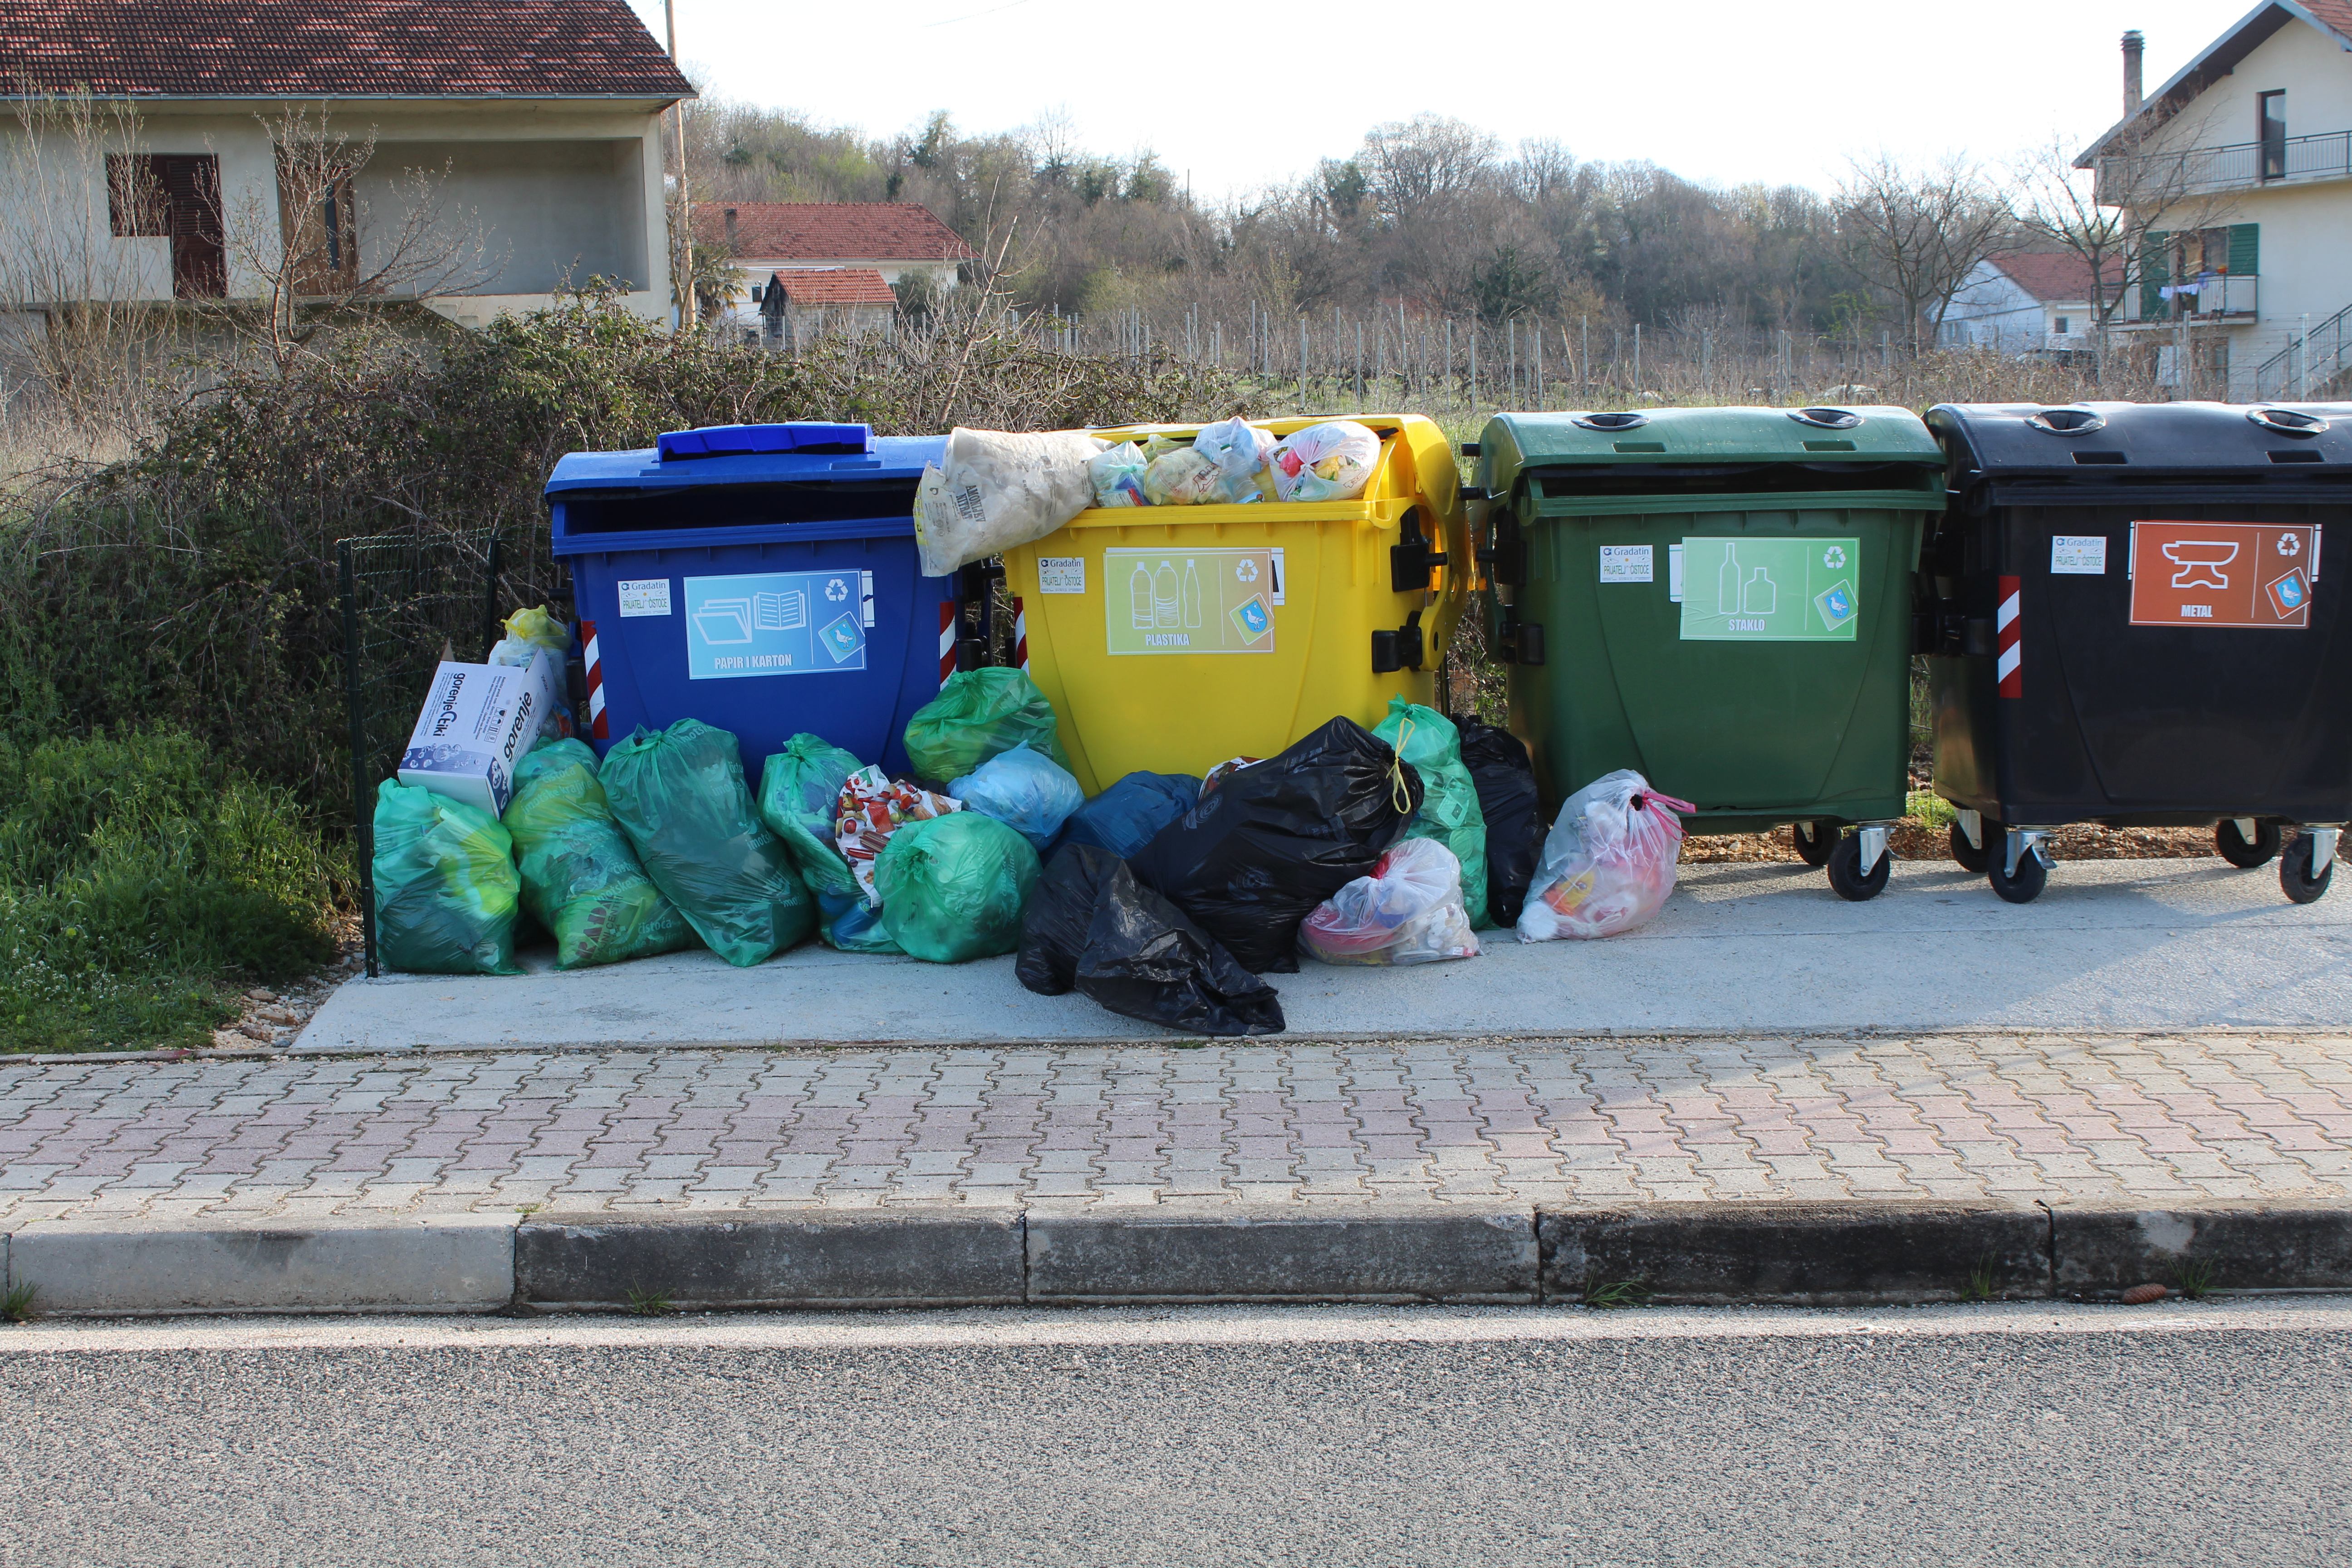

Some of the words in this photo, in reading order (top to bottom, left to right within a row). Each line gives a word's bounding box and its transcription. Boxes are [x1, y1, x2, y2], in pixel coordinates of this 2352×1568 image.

[956, 494, 973, 520] NITRAT
[965, 485, 986, 523] AMONIJEV
[2067, 538, 2102, 546] Gradatin
[1604, 565, 1625, 574] PRIJATELJ
[1631, 563, 1649, 574] ČISTOĆE
[632, 581, 666, 590] Gradatin
[1042, 577, 1061, 586] PRIJATELJ
[623, 600, 644, 609] PRIJATELJ
[649, 597, 667, 608] ČISTOĆE
[2181, 605, 2213, 617] METAL
[1728, 618, 1765, 632] STAKLO
[1145, 633, 1191, 646] PLASTIKA
[715, 657, 744, 670] PAPIR
[746, 656, 750, 669] I
[752, 654, 793, 668] KARTON
[443, 672, 466, 713] gorenje
[502, 691, 532, 763] gorenje
[638, 917, 672, 934] čistoća
